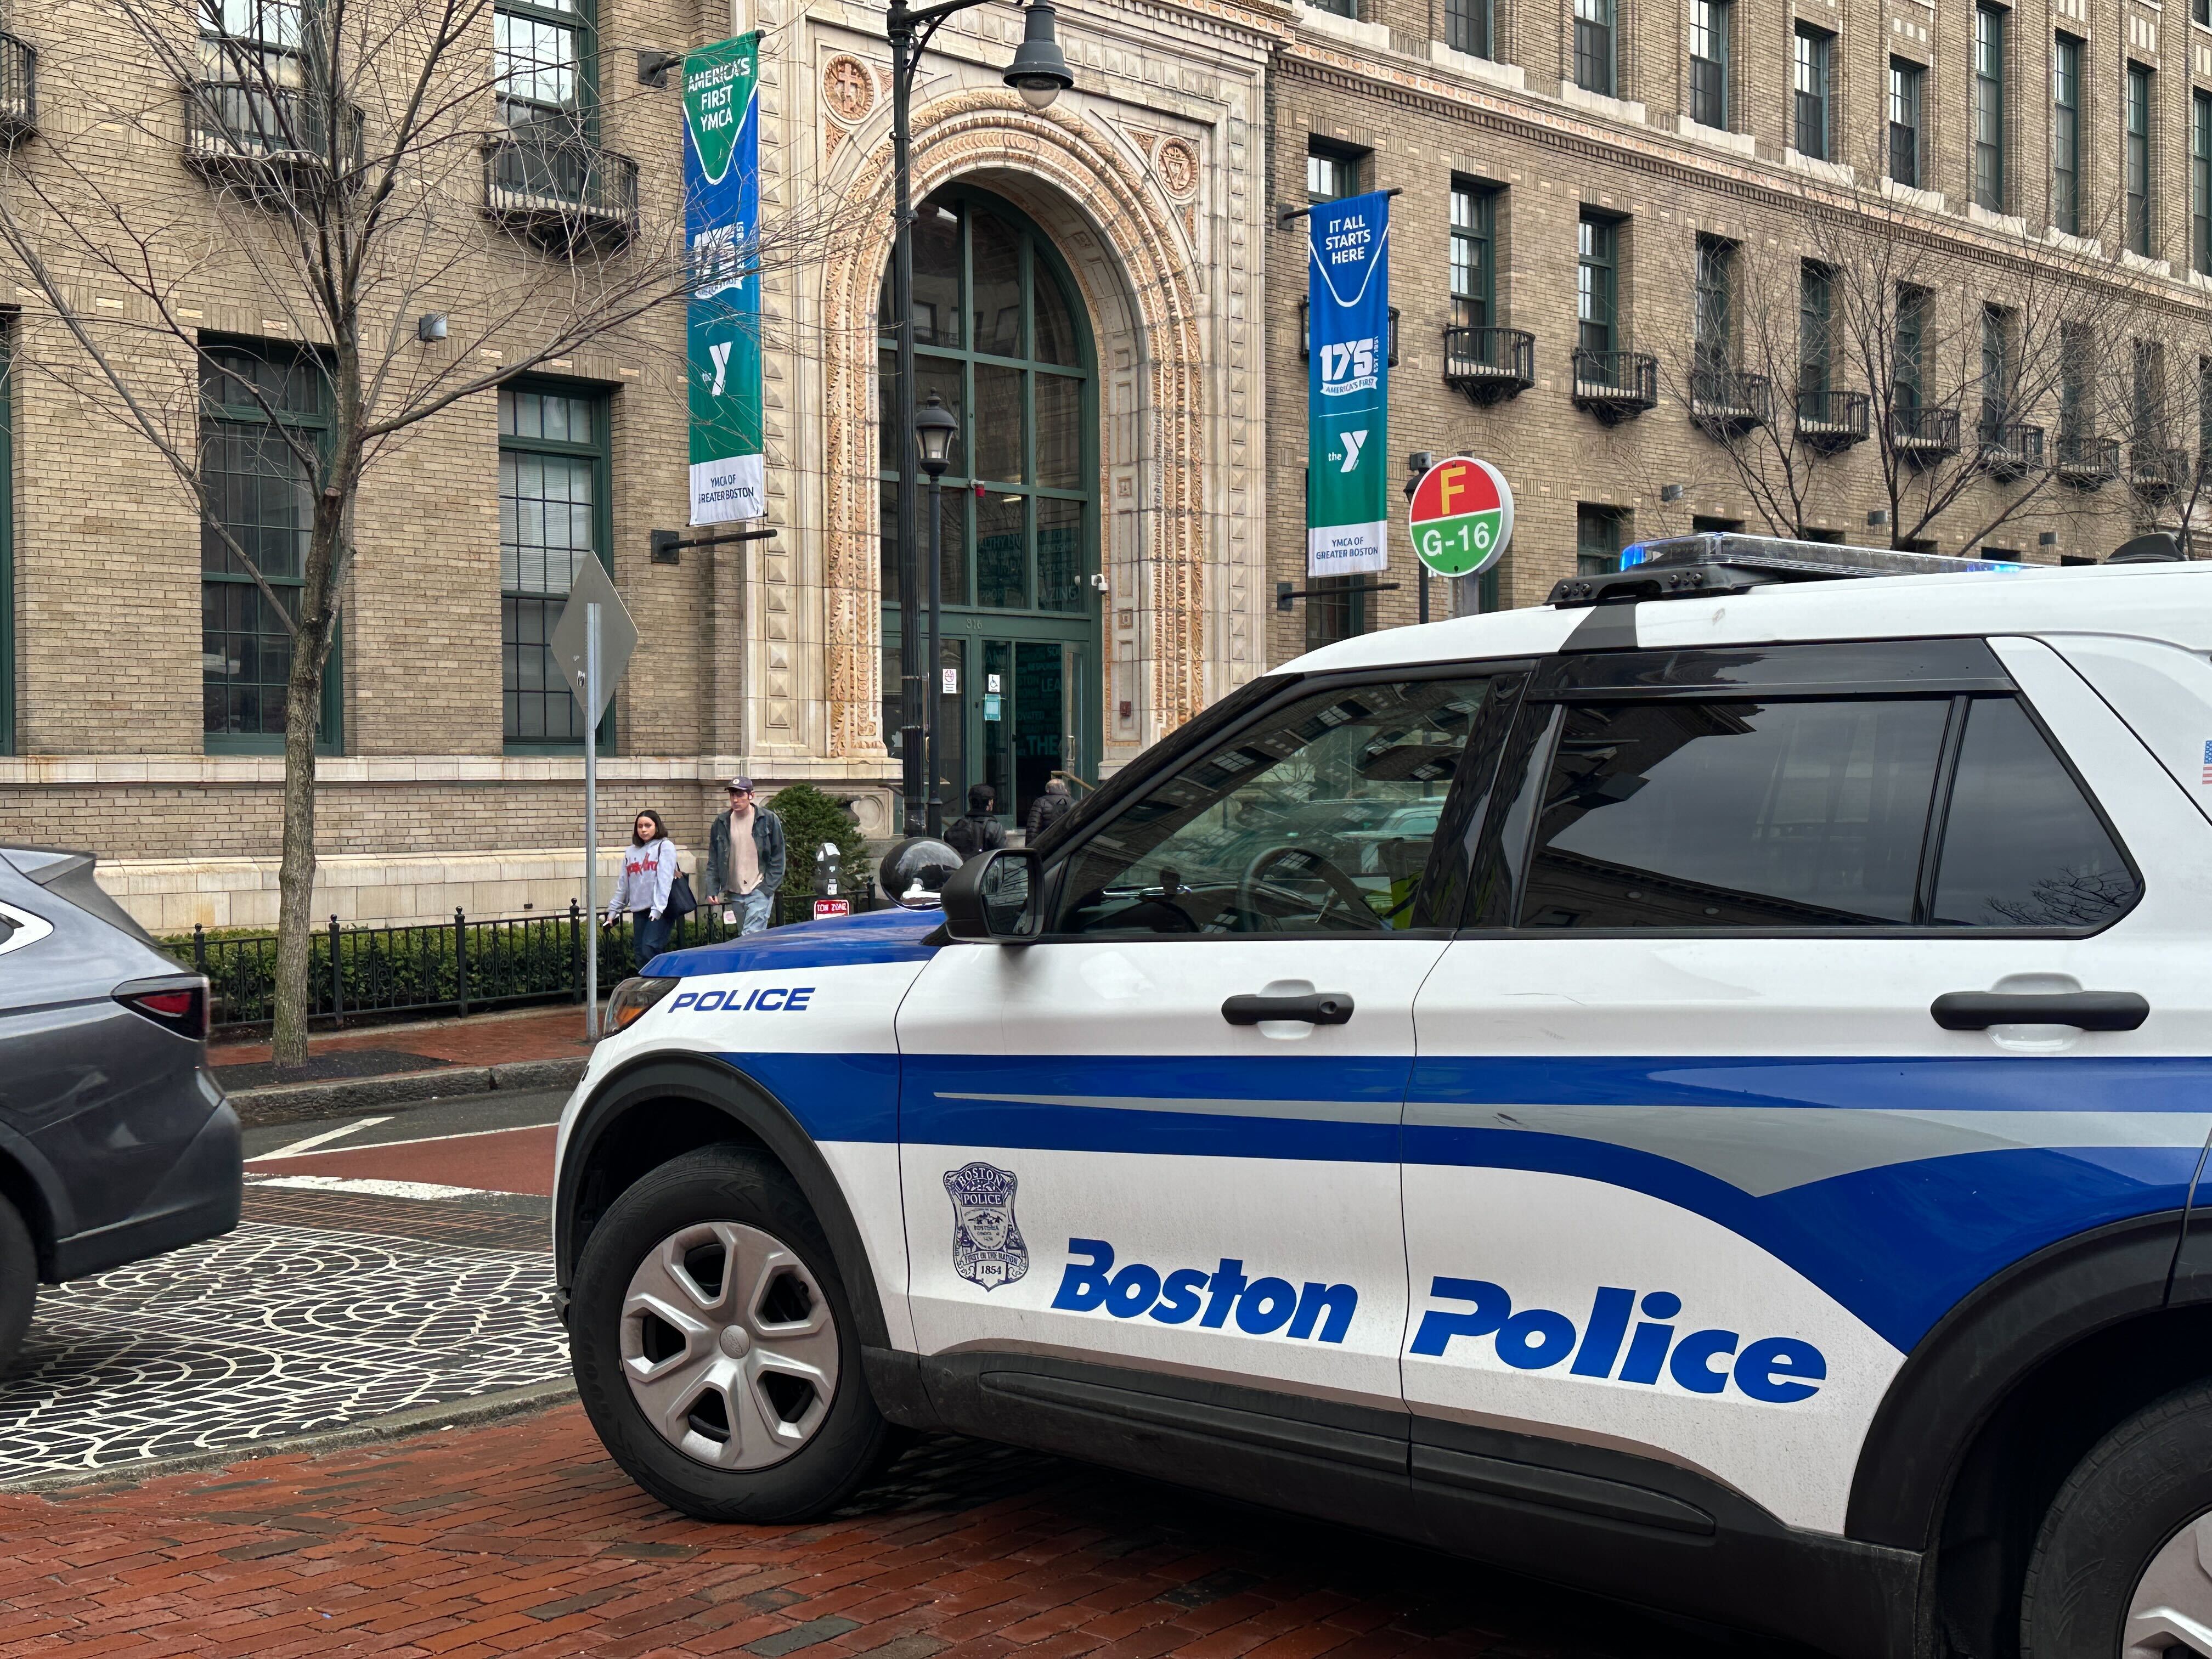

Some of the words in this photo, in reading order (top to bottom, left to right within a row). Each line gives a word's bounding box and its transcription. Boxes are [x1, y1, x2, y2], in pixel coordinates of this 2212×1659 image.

[688, 57, 751, 93] AMERICA'S
[701, 84, 733, 111] FIRST
[700, 107, 733, 132] YMCA
[1329, 218, 1341, 234] IT
[1343, 215, 1365, 232] ALL
[1325, 229, 1370, 250] STARTS
[1331, 247, 1365, 264] HERE
[1320, 338, 1373, 381] 175
[1325, 381, 1358, 393] AMERICA'S
[1328, 451, 1342, 461] the
[728, 474, 736, 485] OF
[725, 487, 754, 500] BOSTON
[1440, 466, 1466, 515] F
[1332, 537, 1353, 548] YMCA
[1354, 536, 1364, 545] OF
[1422, 522, 1490, 557] G-16
[1316, 549, 1347, 560] GREATER
[1349, 546, 1378, 557] BOSTON
[667, 987, 816, 1014] POLICE
[958, 1167, 1003, 1187] BOSTON
[963, 1194, 1002, 1205] POLICE
[981, 1265, 1002, 1274] 1854
[1050, 1237, 1359, 1344] Boston
[1408, 1276, 1828, 1403] Police
